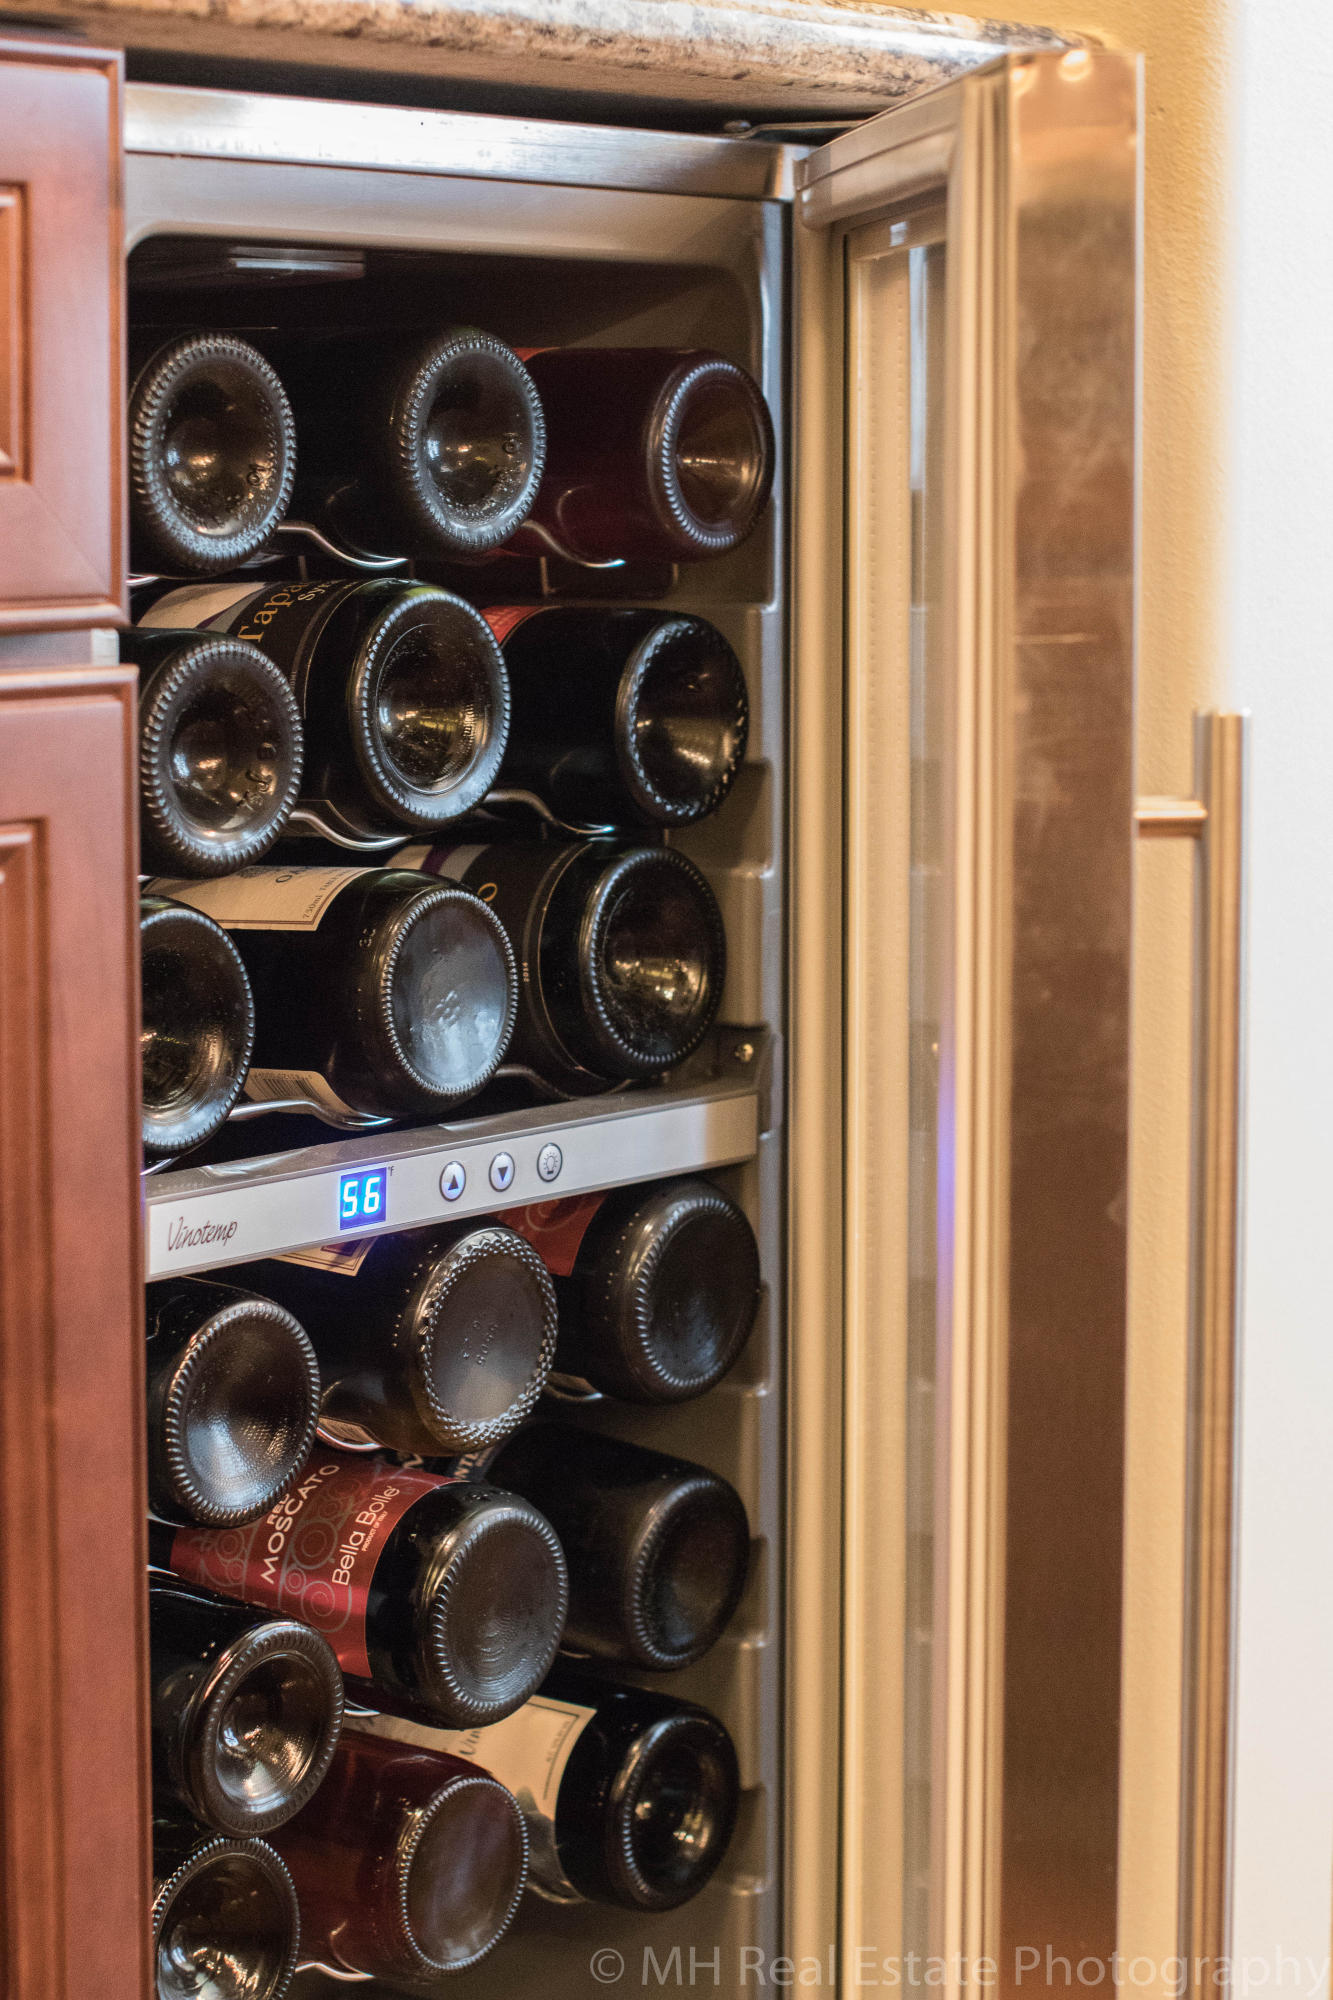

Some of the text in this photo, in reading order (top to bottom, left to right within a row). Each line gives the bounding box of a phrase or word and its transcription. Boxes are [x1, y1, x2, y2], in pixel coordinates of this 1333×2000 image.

[342, 1175, 381, 1218] 56
[167, 1216, 238, 1252] Vinotemp
[260, 1464, 341, 1585] MOSCATO
[331, 1530, 367, 1586] Bella
